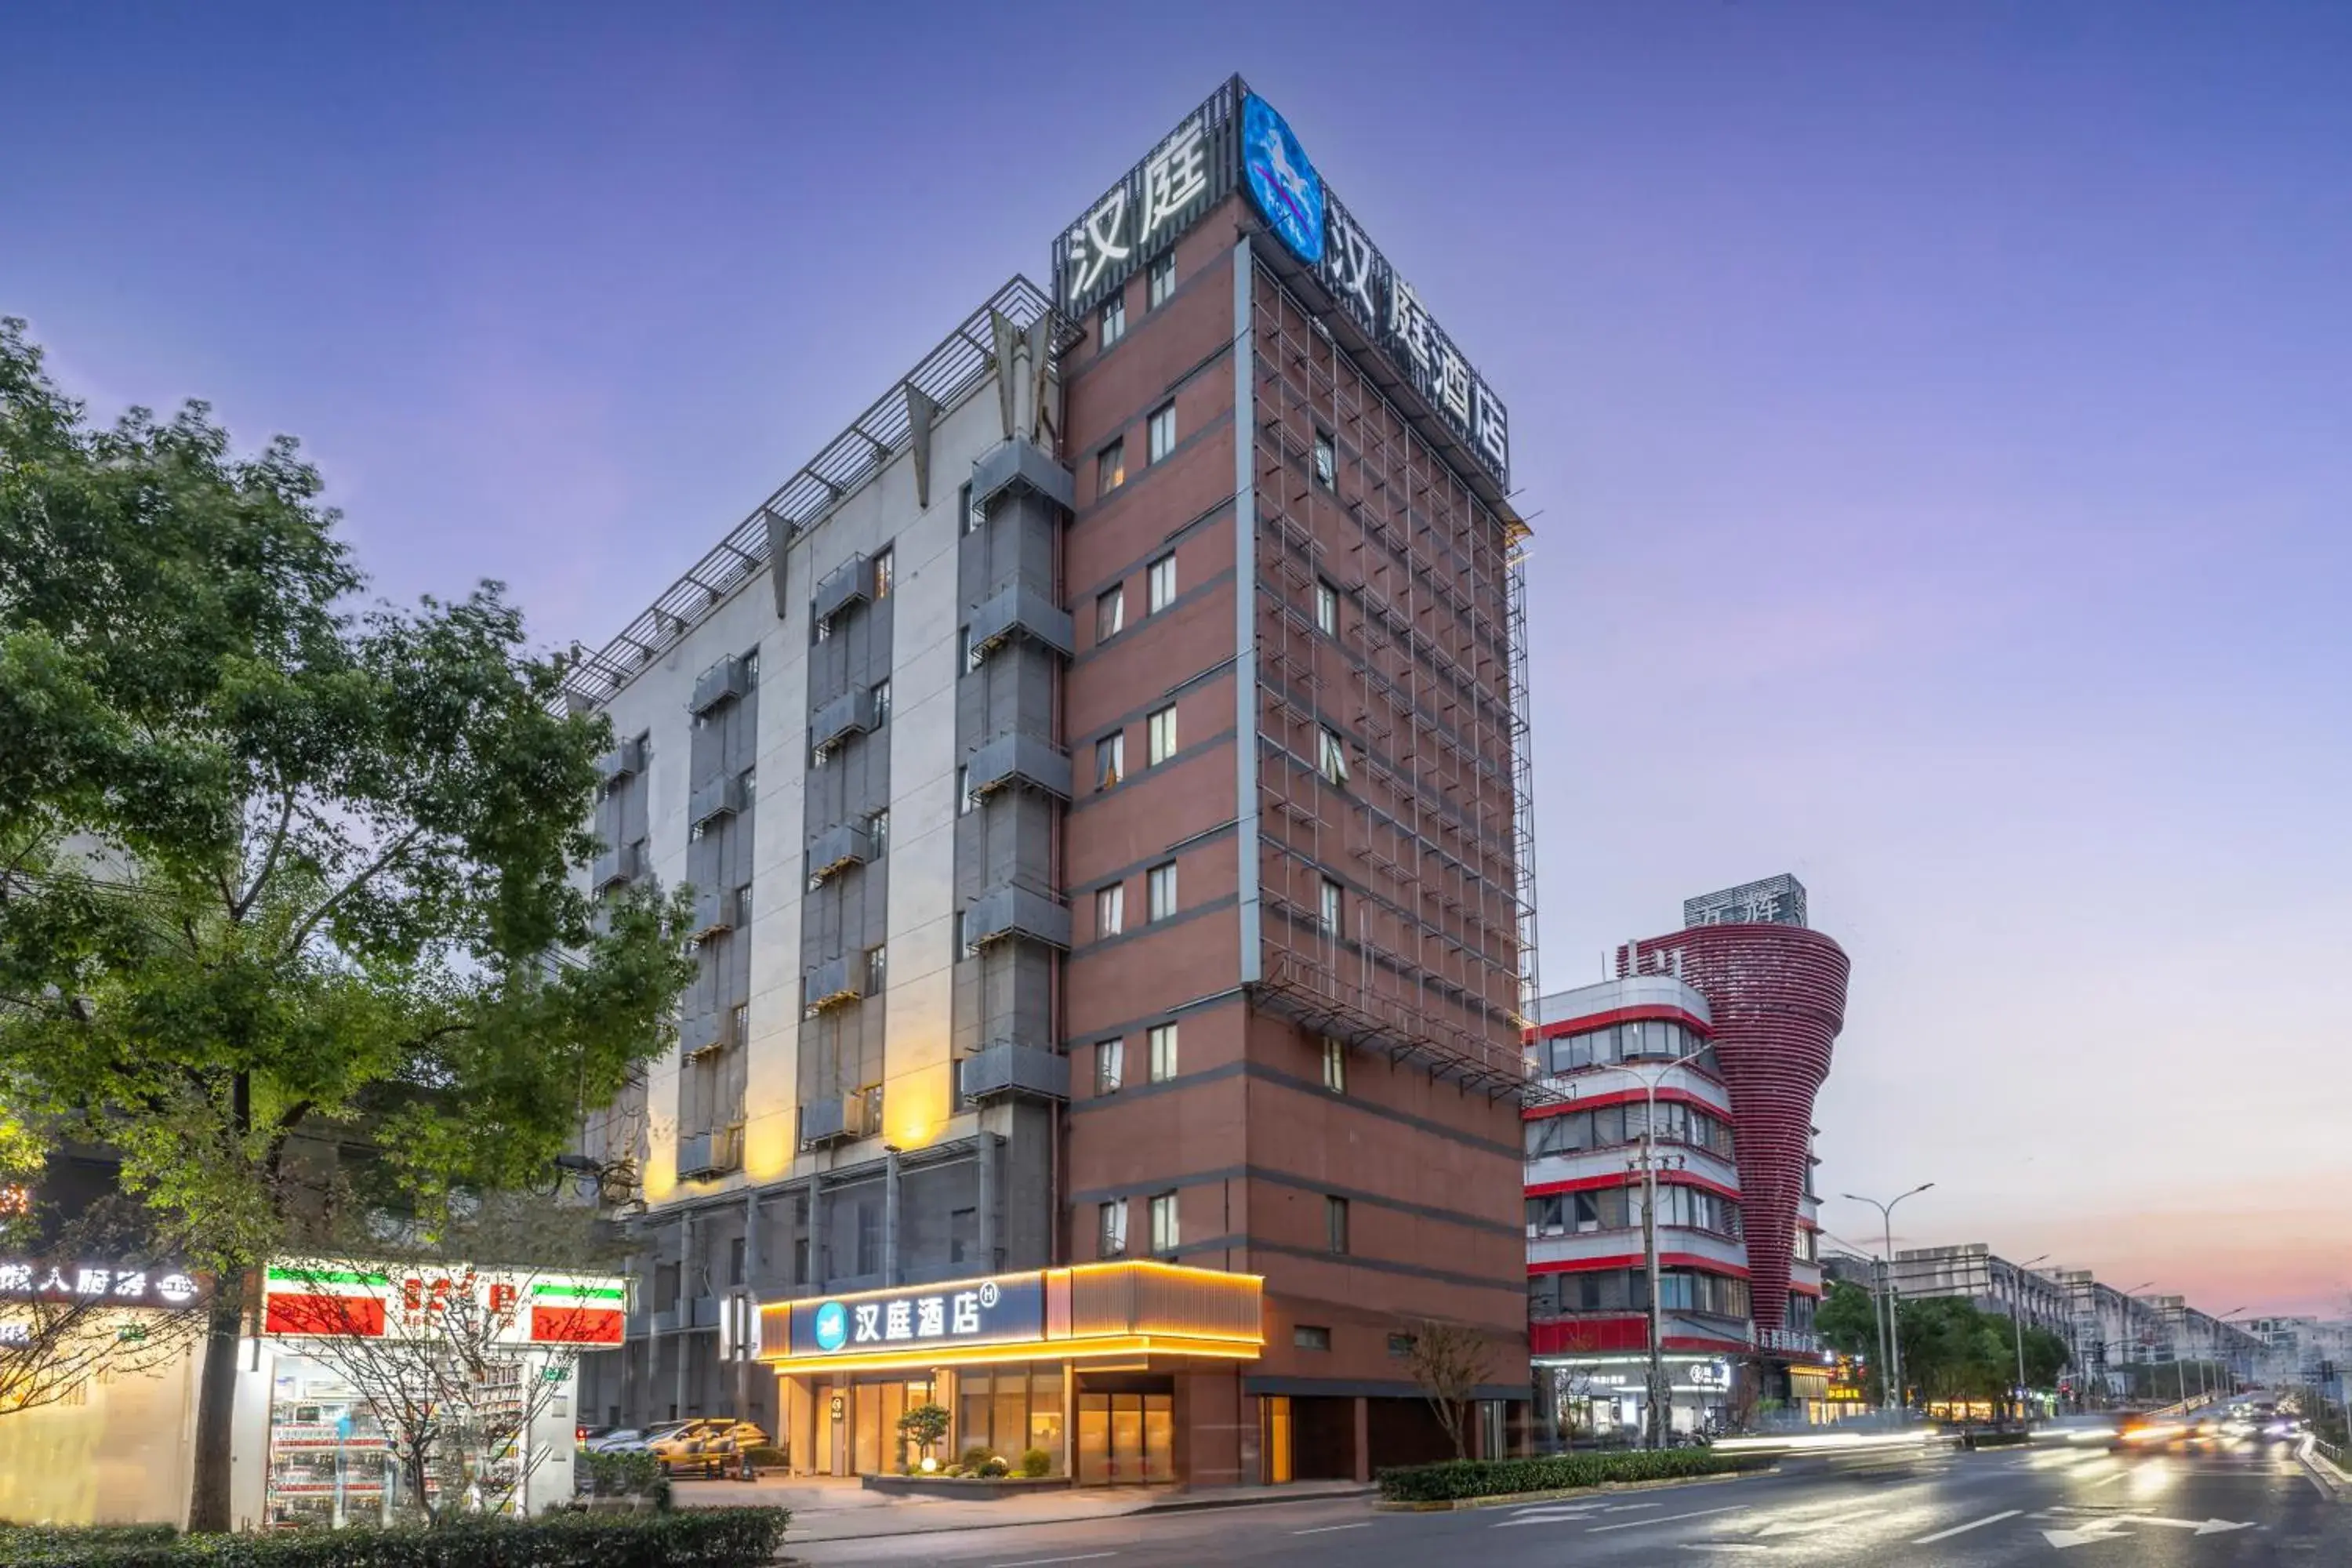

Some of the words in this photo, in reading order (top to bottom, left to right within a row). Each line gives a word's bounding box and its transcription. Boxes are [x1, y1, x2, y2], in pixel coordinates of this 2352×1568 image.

[1069, 118, 1207, 300] 汉庭
[1331, 209, 1506, 470] 汉庭酒店
[855, 1292, 979, 1341] 汉庭酒店
